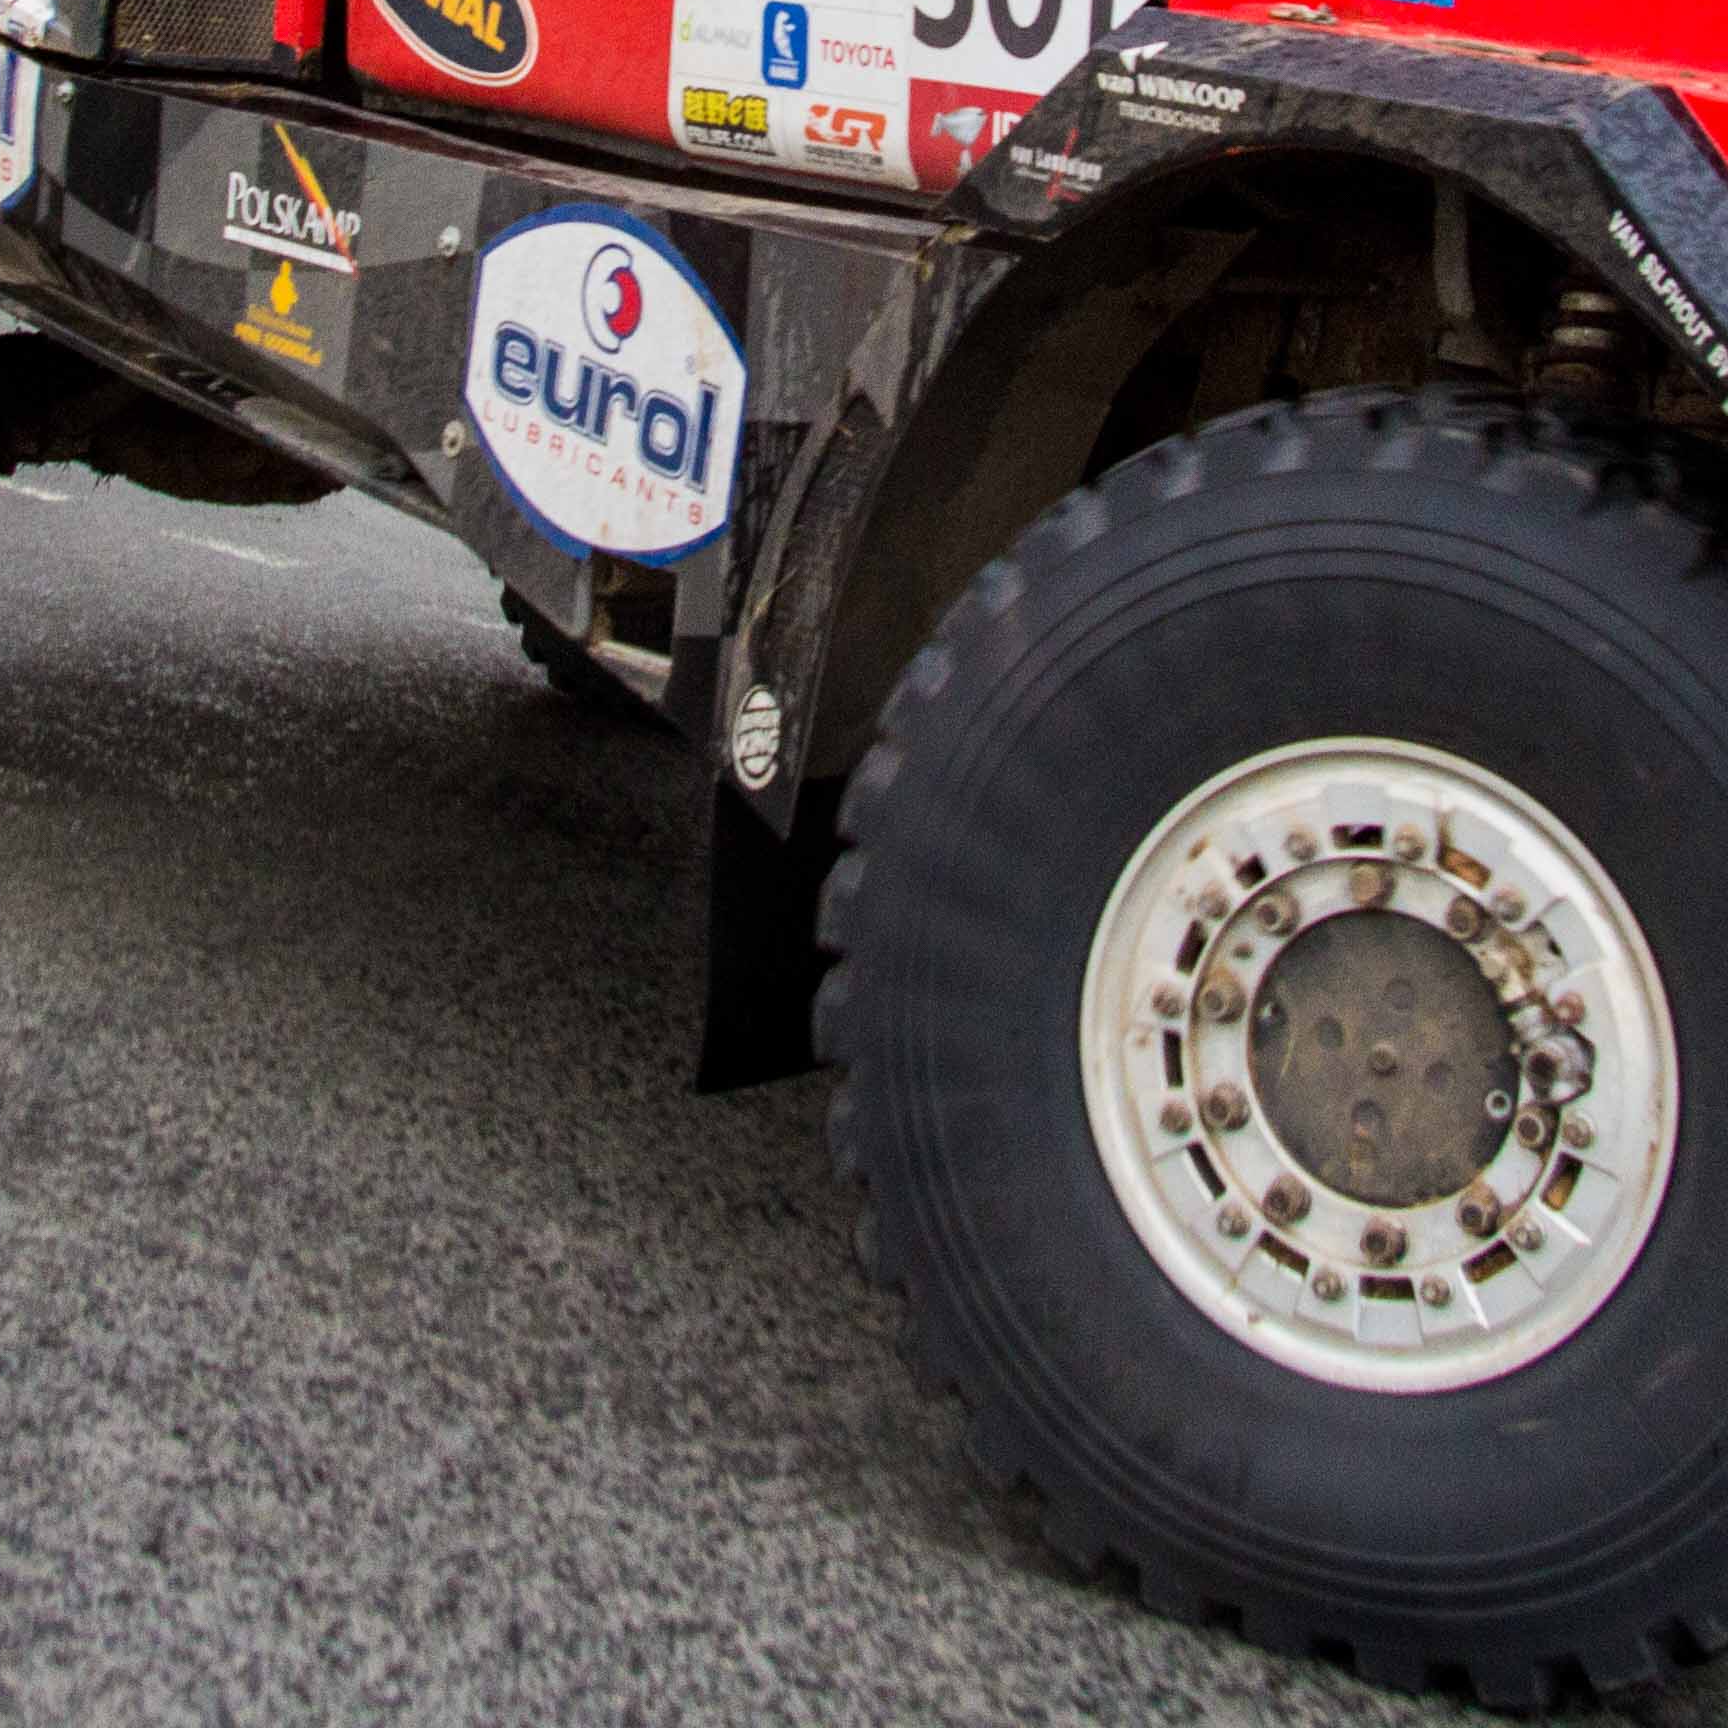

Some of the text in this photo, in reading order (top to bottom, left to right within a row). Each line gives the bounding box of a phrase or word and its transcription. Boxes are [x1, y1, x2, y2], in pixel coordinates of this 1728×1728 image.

[821, 40, 897, 70] TOYOTA
[483, 406, 703, 525] LUBRICANTS
[492, 321, 719, 493] eurol
